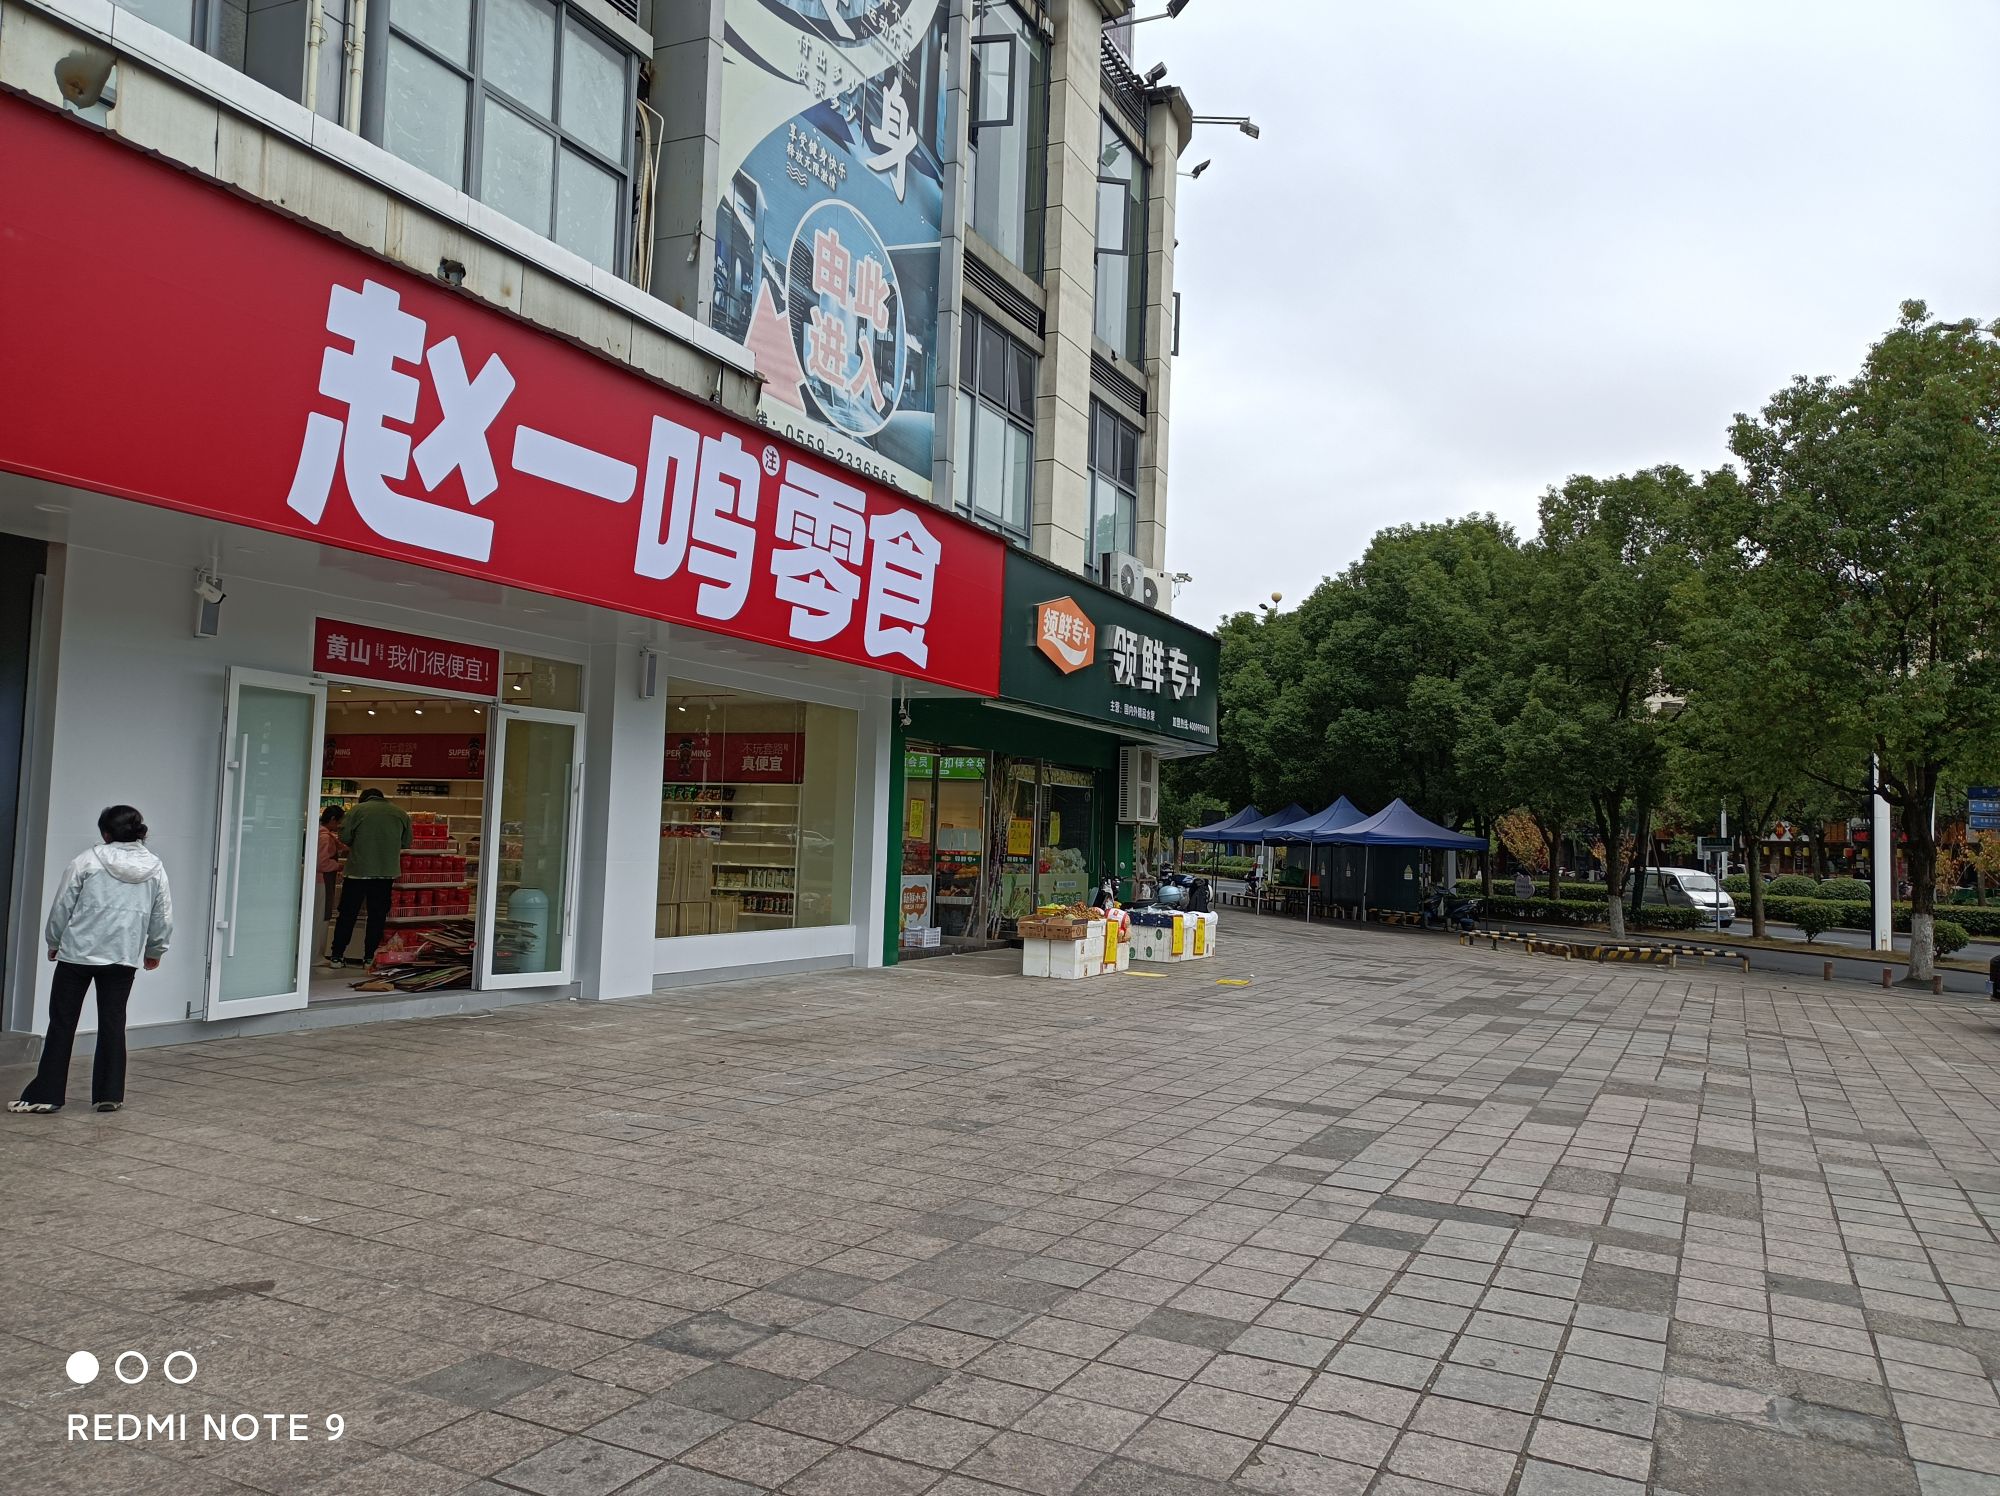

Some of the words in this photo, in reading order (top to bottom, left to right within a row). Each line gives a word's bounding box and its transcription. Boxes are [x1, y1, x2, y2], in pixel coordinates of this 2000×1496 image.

[788, 122, 847, 180] 享受健身快乐
[865, 76, 918, 202] 身
[786, 142, 837, 191] 释放无限激情
[812, 227, 890, 333] 由此
[806, 305, 886, 413] 进入
[287, 279, 943, 670] 赵一鸣零食
[765, 449, 777, 472] 注
[326, 633, 371, 666] 黄山
[387, 643, 489, 683] 我们很便宜!
[334, 748, 351, 756] MING
[380, 754, 413, 768] 真便宜
[448, 749, 470, 757] SUPER
[666, 750, 681, 758] PER
[691, 749, 712, 758] MING
[741, 756, 783, 772] 真便宜
[742, 743, 784, 756] 不玩套路
